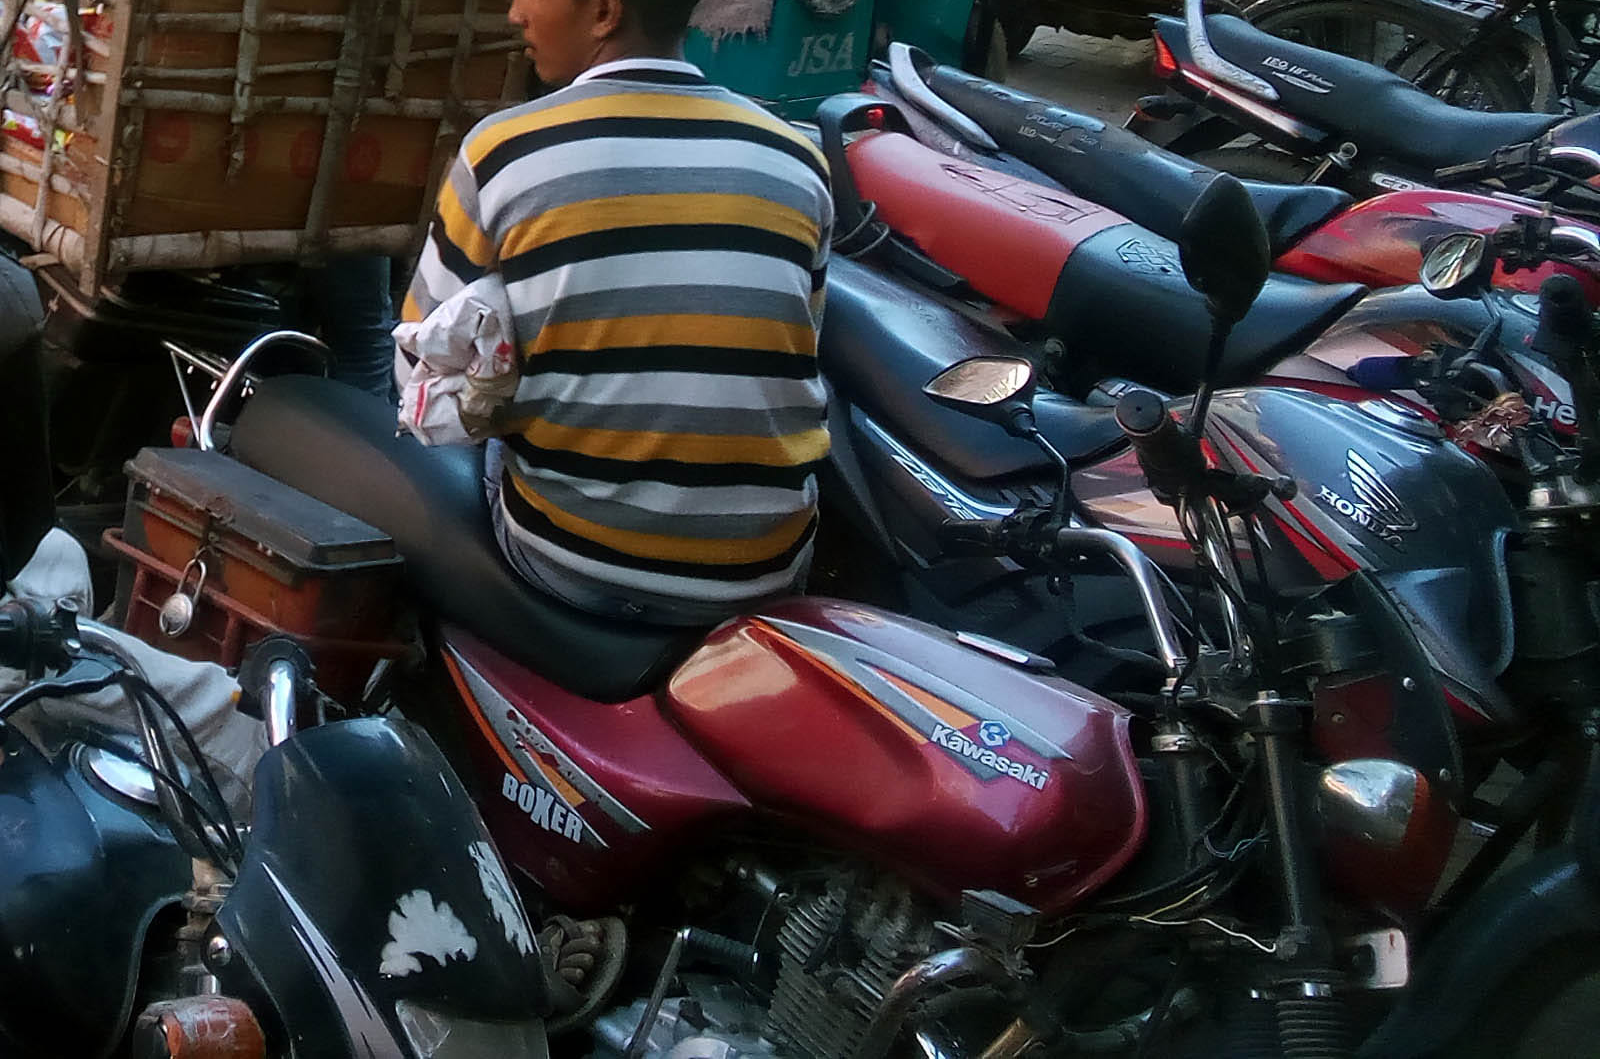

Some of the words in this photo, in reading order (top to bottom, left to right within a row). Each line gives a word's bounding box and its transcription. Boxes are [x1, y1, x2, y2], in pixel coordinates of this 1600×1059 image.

[786, 31, 855, 77] JSA
[1534, 396, 1578, 426] He
[930, 723, 1050, 790] Kawasaki
[502, 772, 584, 844] BOXER
